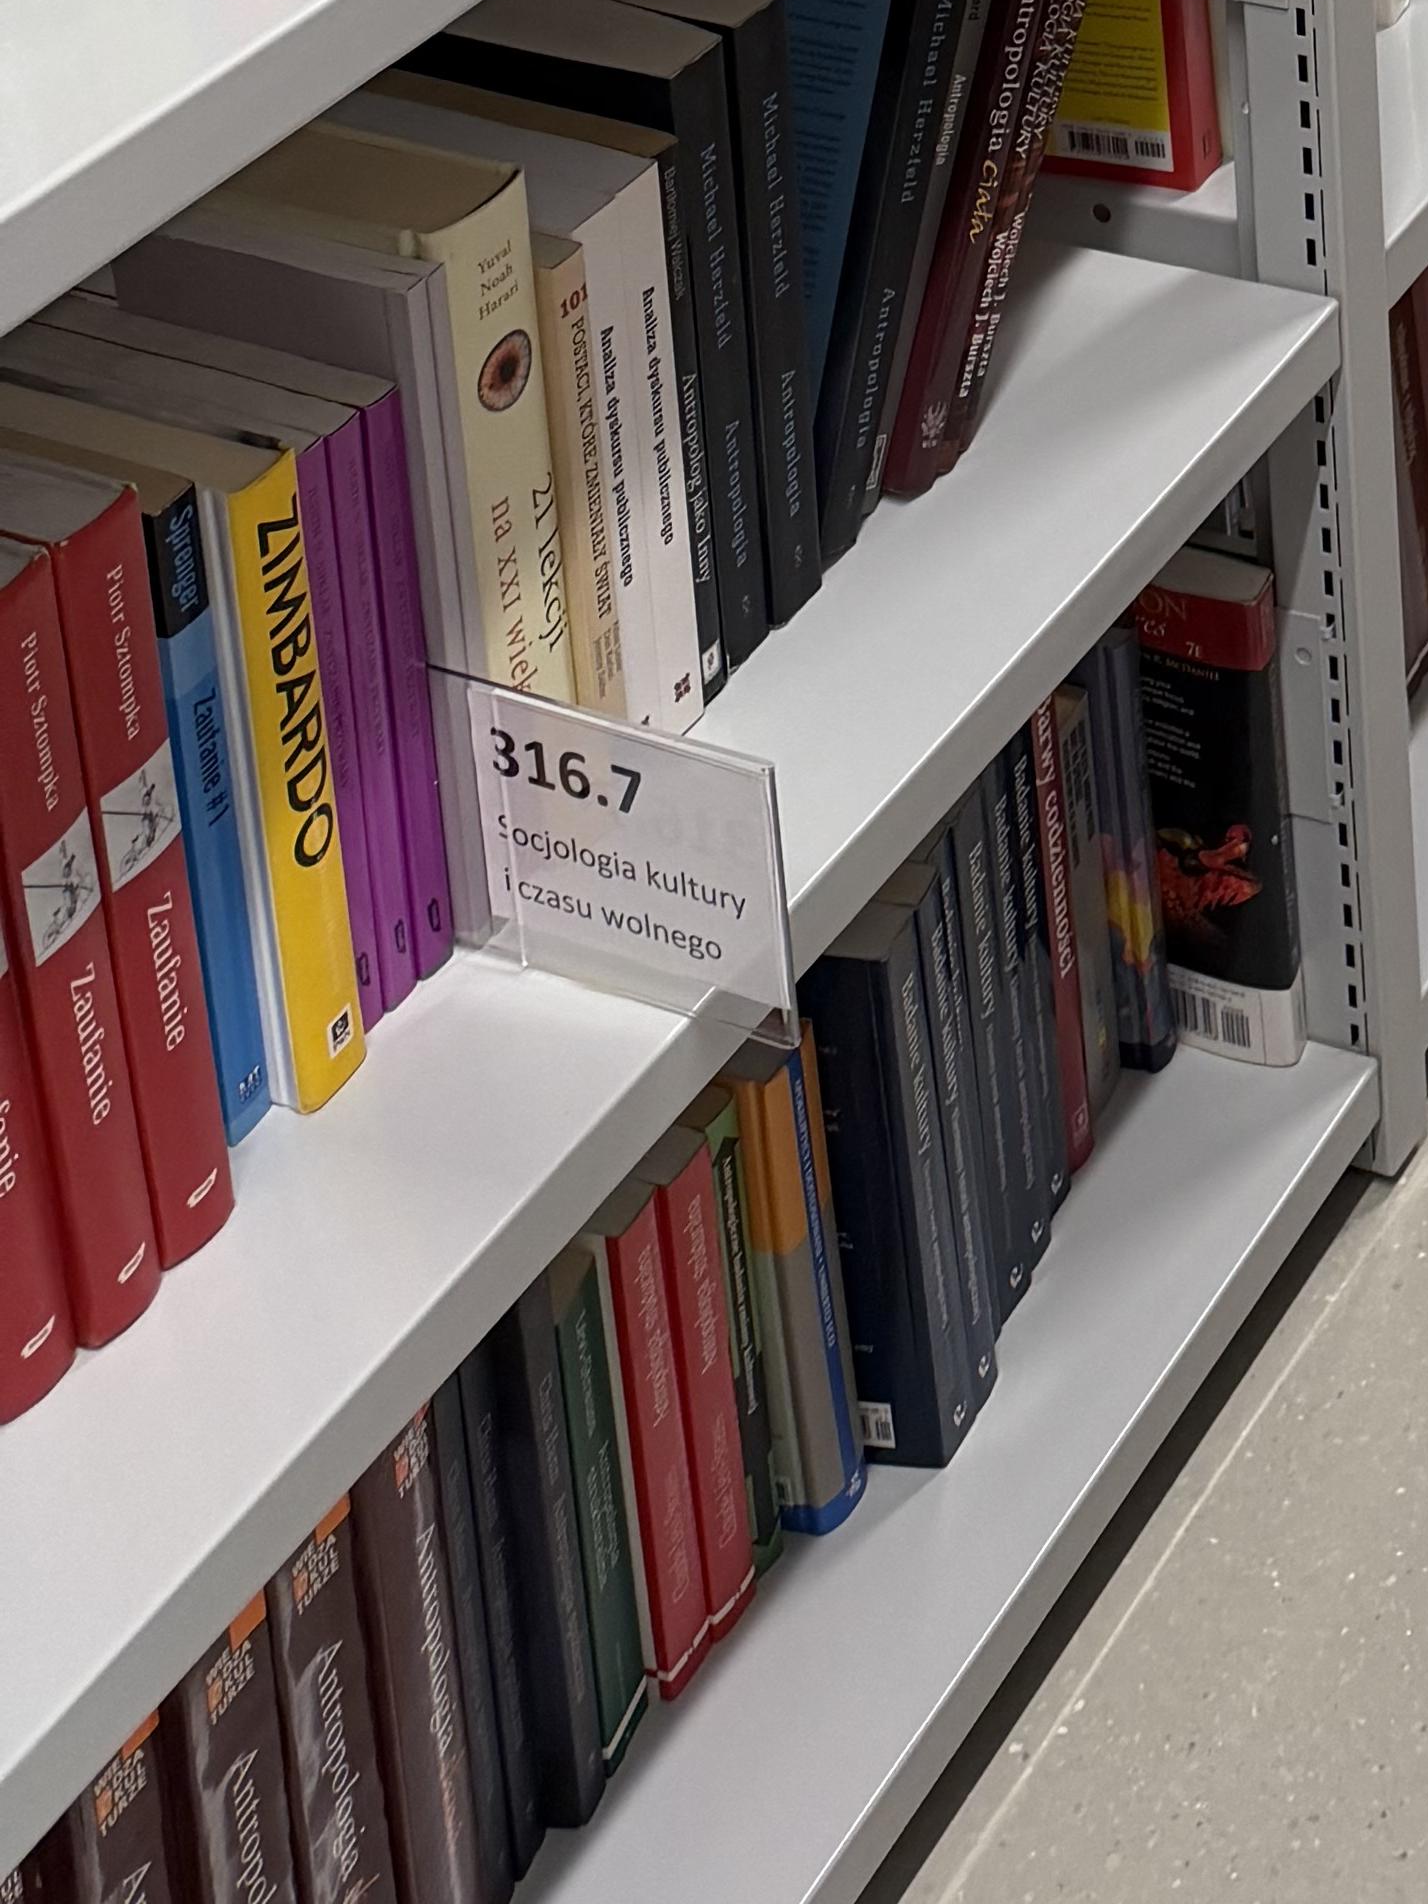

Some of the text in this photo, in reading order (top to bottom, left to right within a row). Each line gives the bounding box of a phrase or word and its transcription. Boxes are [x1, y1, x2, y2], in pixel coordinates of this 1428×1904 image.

[475, 239, 513, 275] Yuval
[477, 281, 520, 320] Harari
[478, 264, 515, 297] Noah
[491, 495, 512, 542] na
[497, 548, 522, 613] XXI
[538, 528, 569, 652] lekcji
[256, 493, 332, 869] ZIMBARDO
[107, 563, 188, 1053] Piotr Sztompka Zaufanie
[491, 725, 644, 816] 316.7
[497, 809, 747, 920] Socjologia kultury
[518, 874, 595, 918] czasu
[600, 899, 722, 963] wolnego
[315, 1638, 360, 1884] Antropologia
